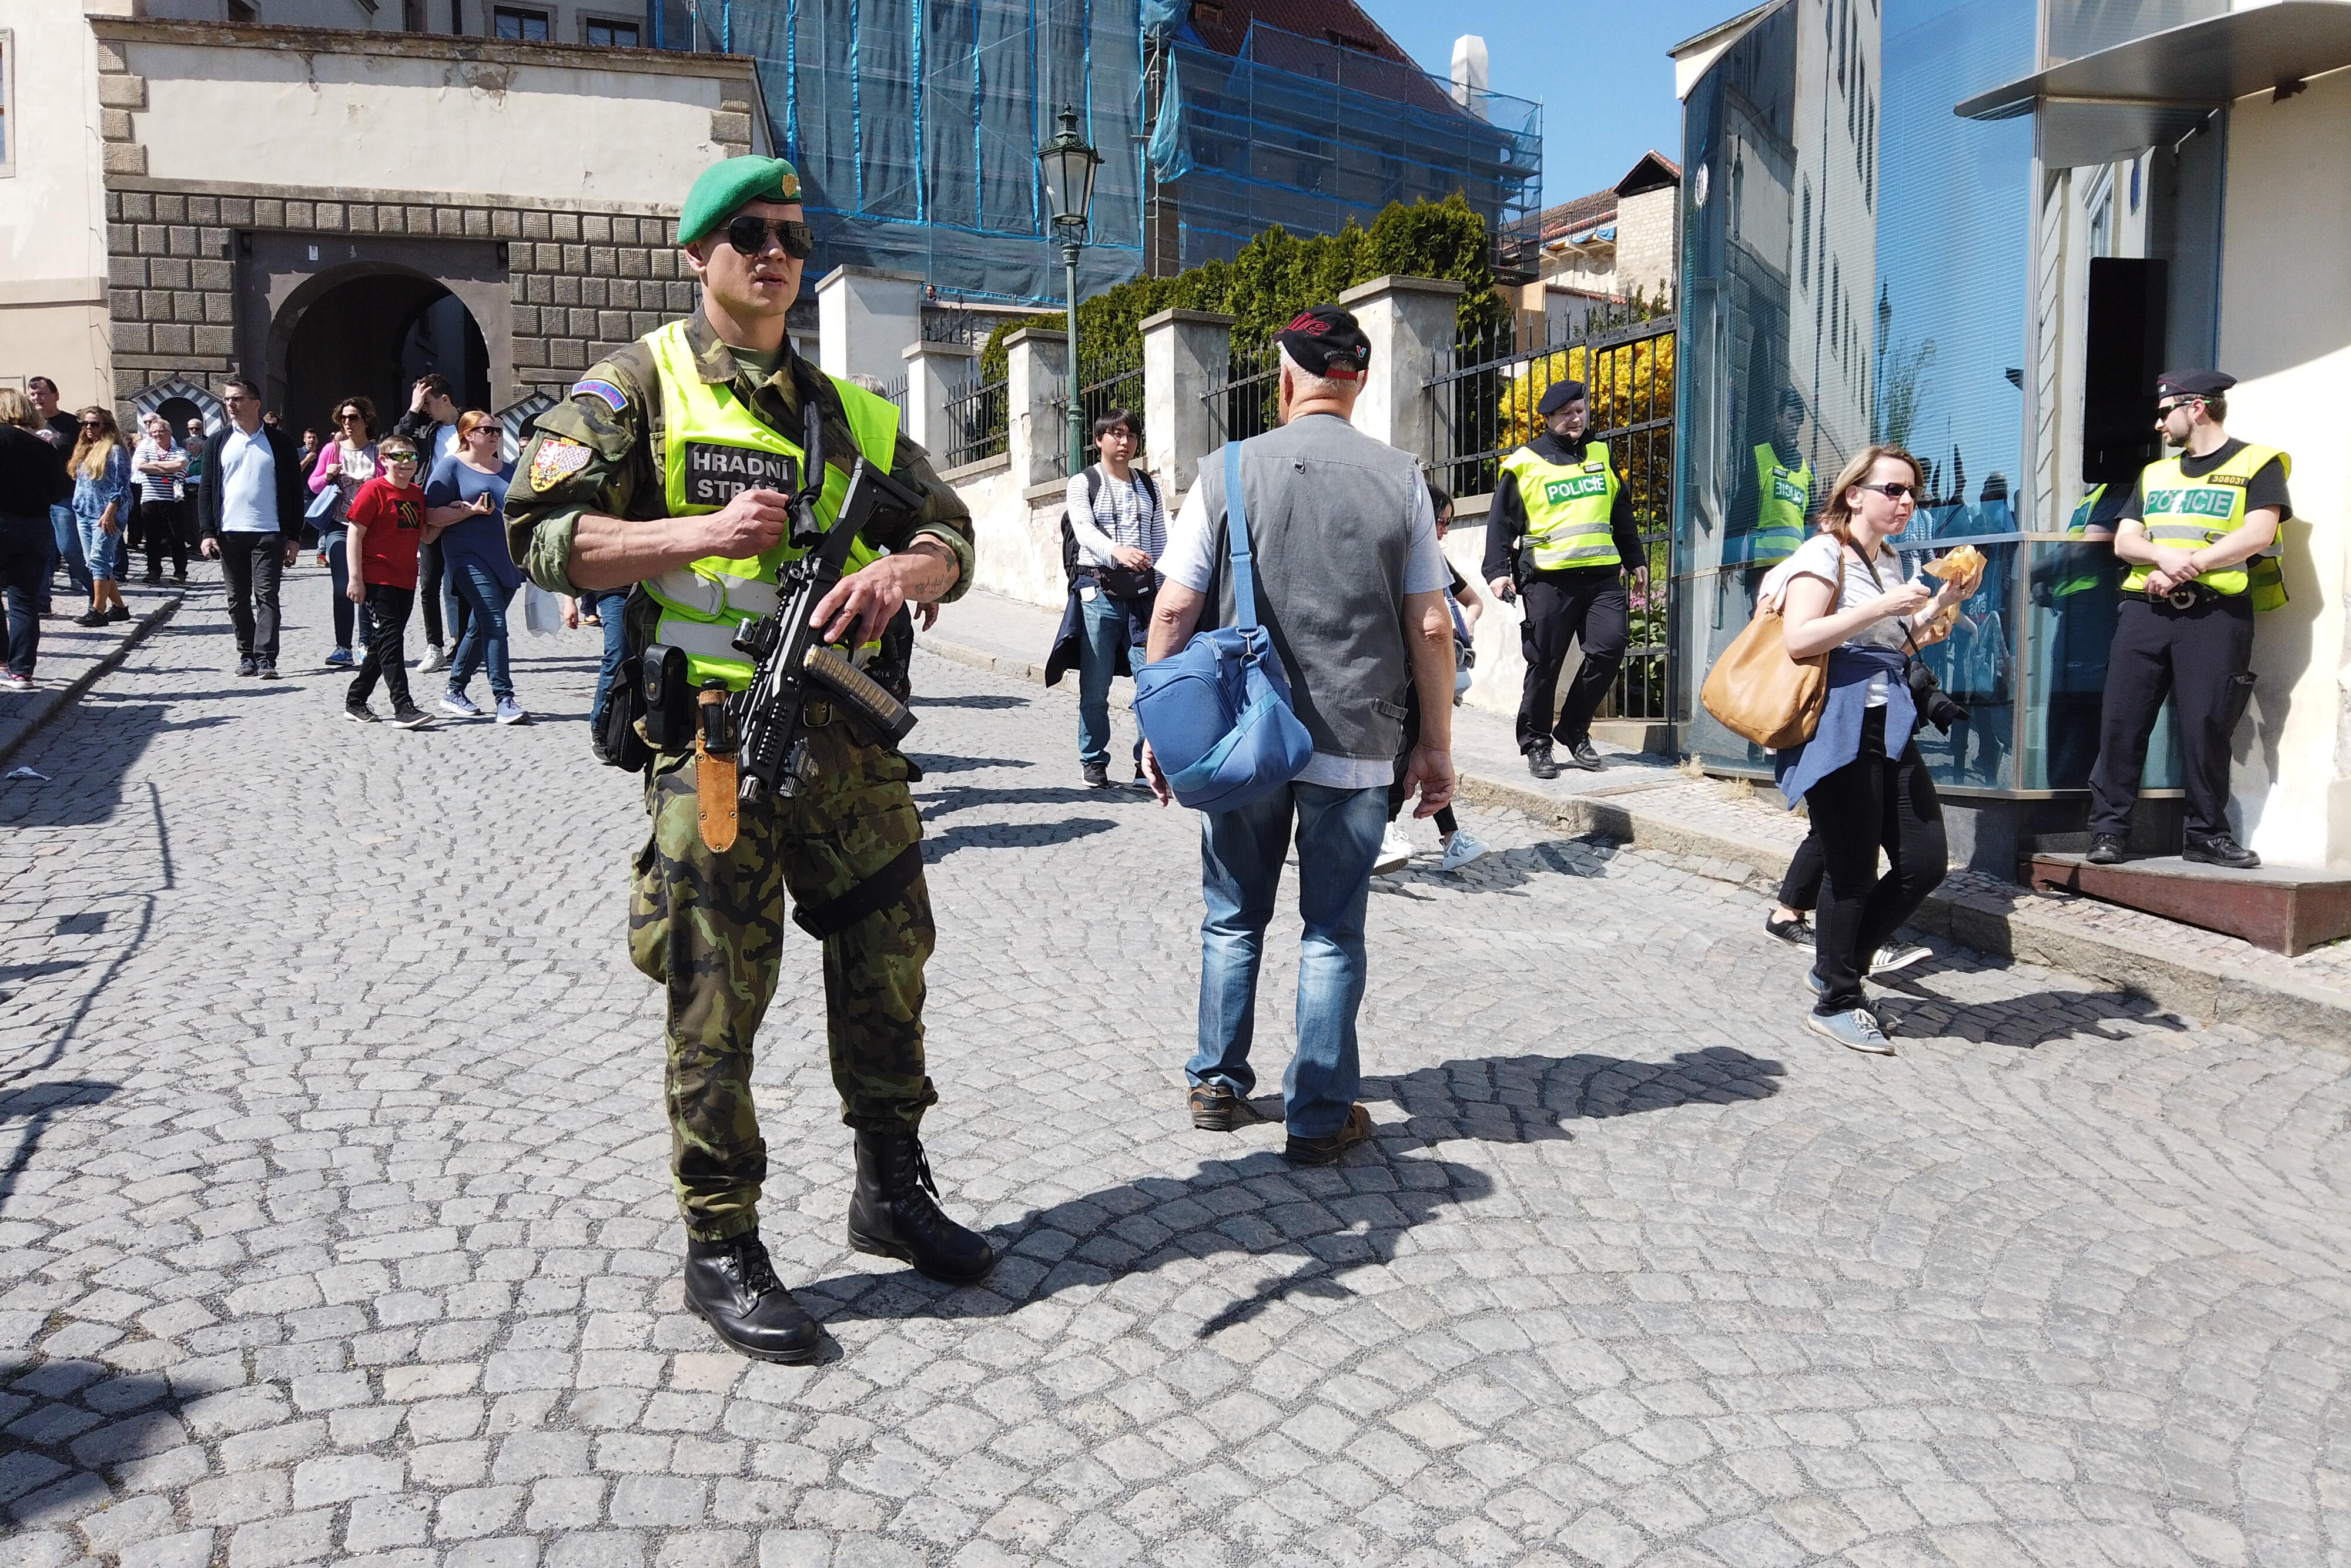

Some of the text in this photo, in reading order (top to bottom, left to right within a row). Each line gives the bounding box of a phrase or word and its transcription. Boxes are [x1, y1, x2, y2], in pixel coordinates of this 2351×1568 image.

[694, 452, 789, 480] HRADNÍ
[1548, 477, 1606, 500] POLICIE
[2212, 475, 2245, 484] 308031
